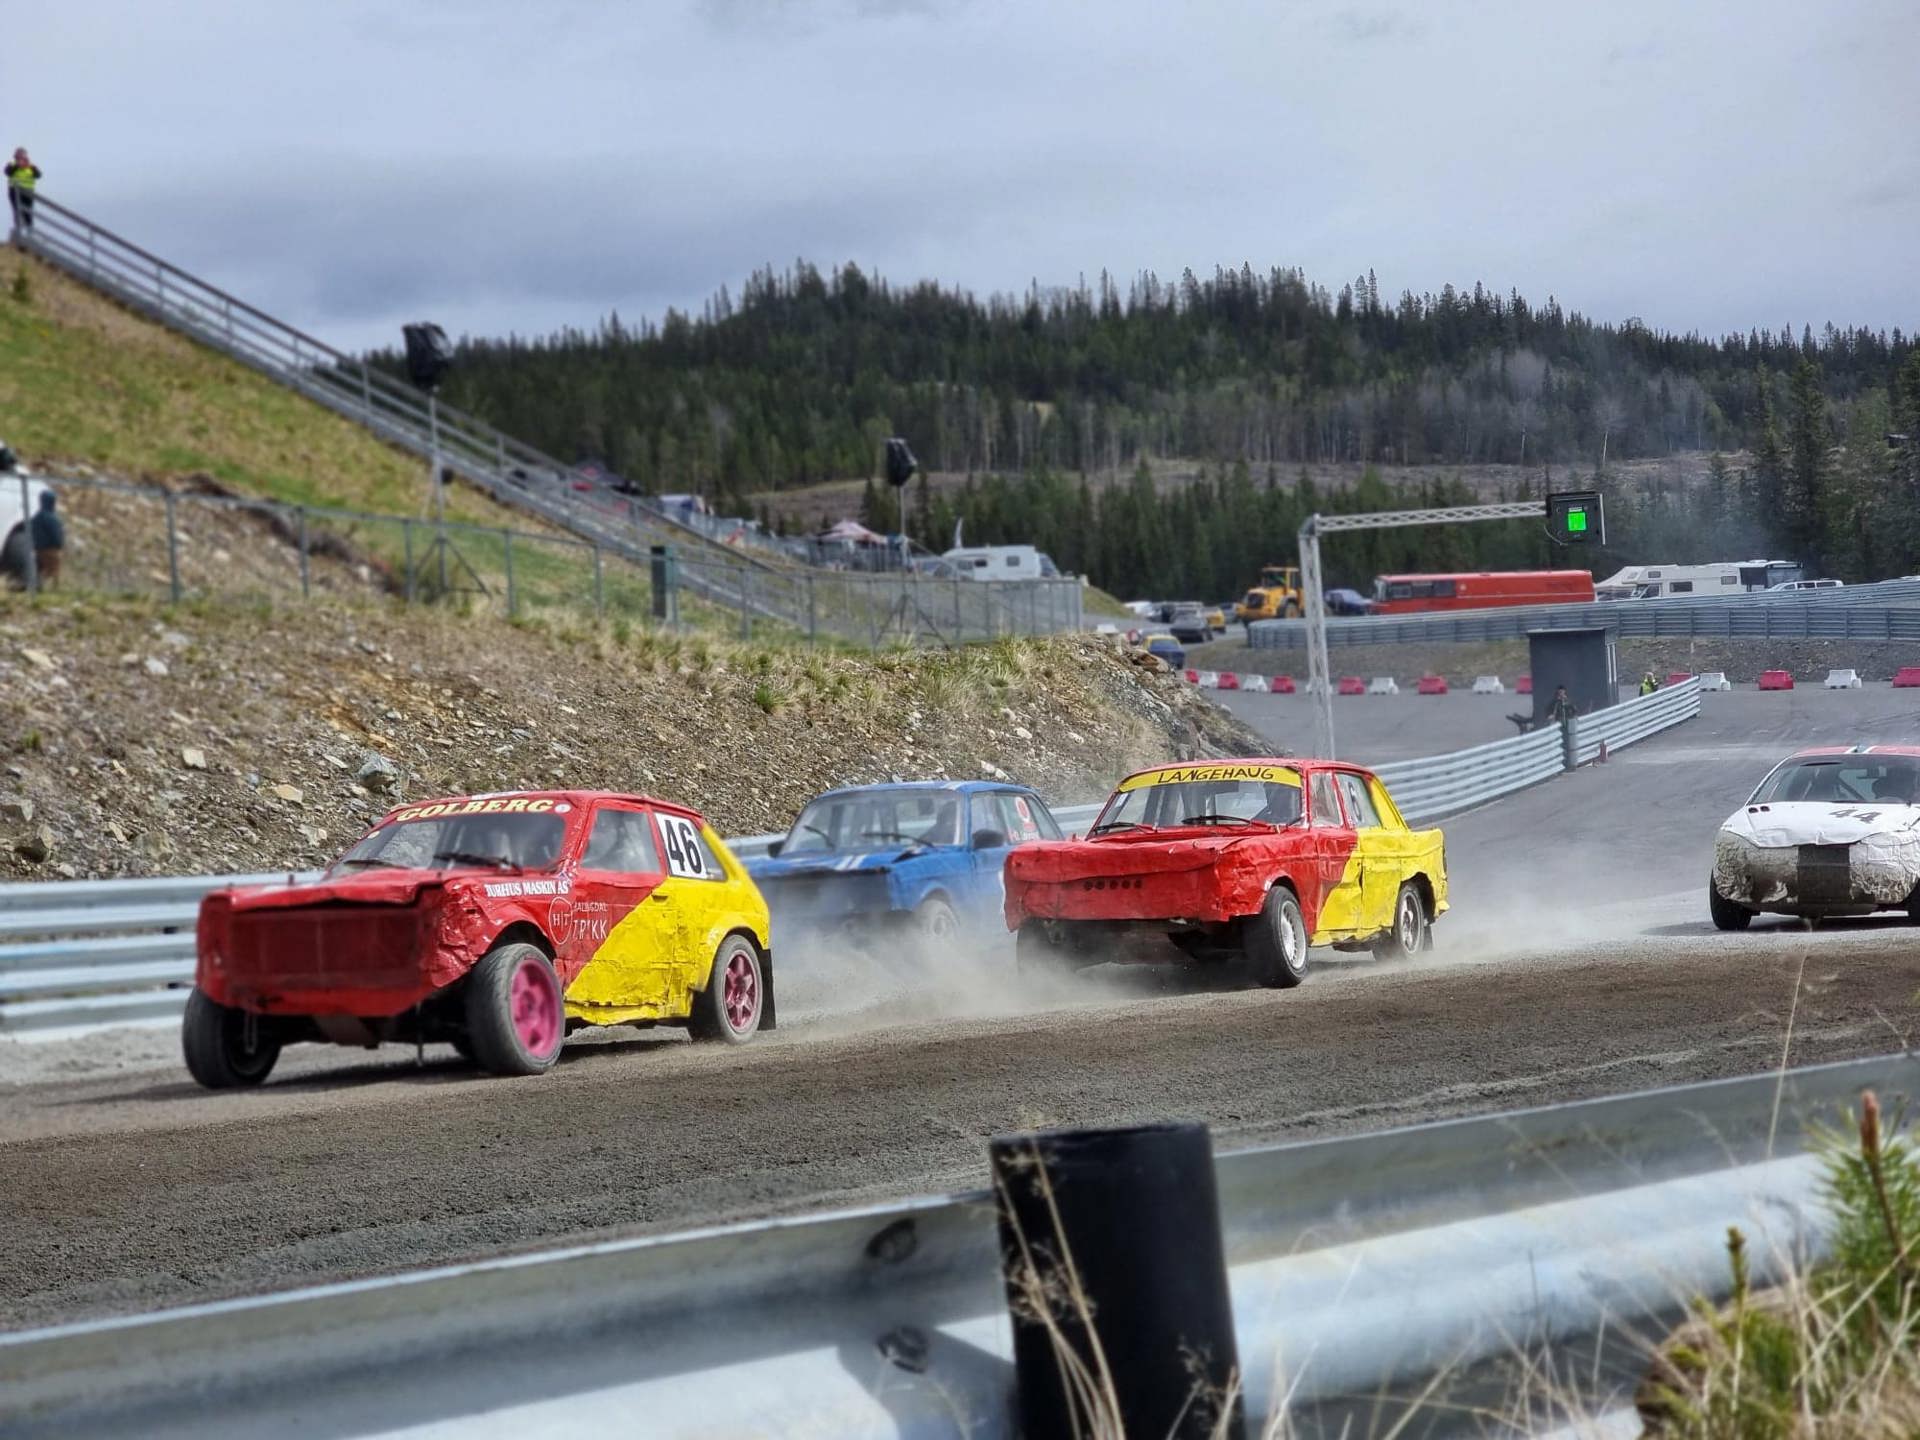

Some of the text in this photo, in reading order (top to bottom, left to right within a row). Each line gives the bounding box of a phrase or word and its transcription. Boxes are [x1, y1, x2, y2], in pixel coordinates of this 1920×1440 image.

[1158, 767, 1274, 783] LANGEHAUG
[396, 799, 554, 822] GOLBERG
[1828, 809, 1882, 824] 44
[664, 819, 702, 874] 46
[523, 880, 556, 895] MASKIN
[557, 880, 569, 894] AS
